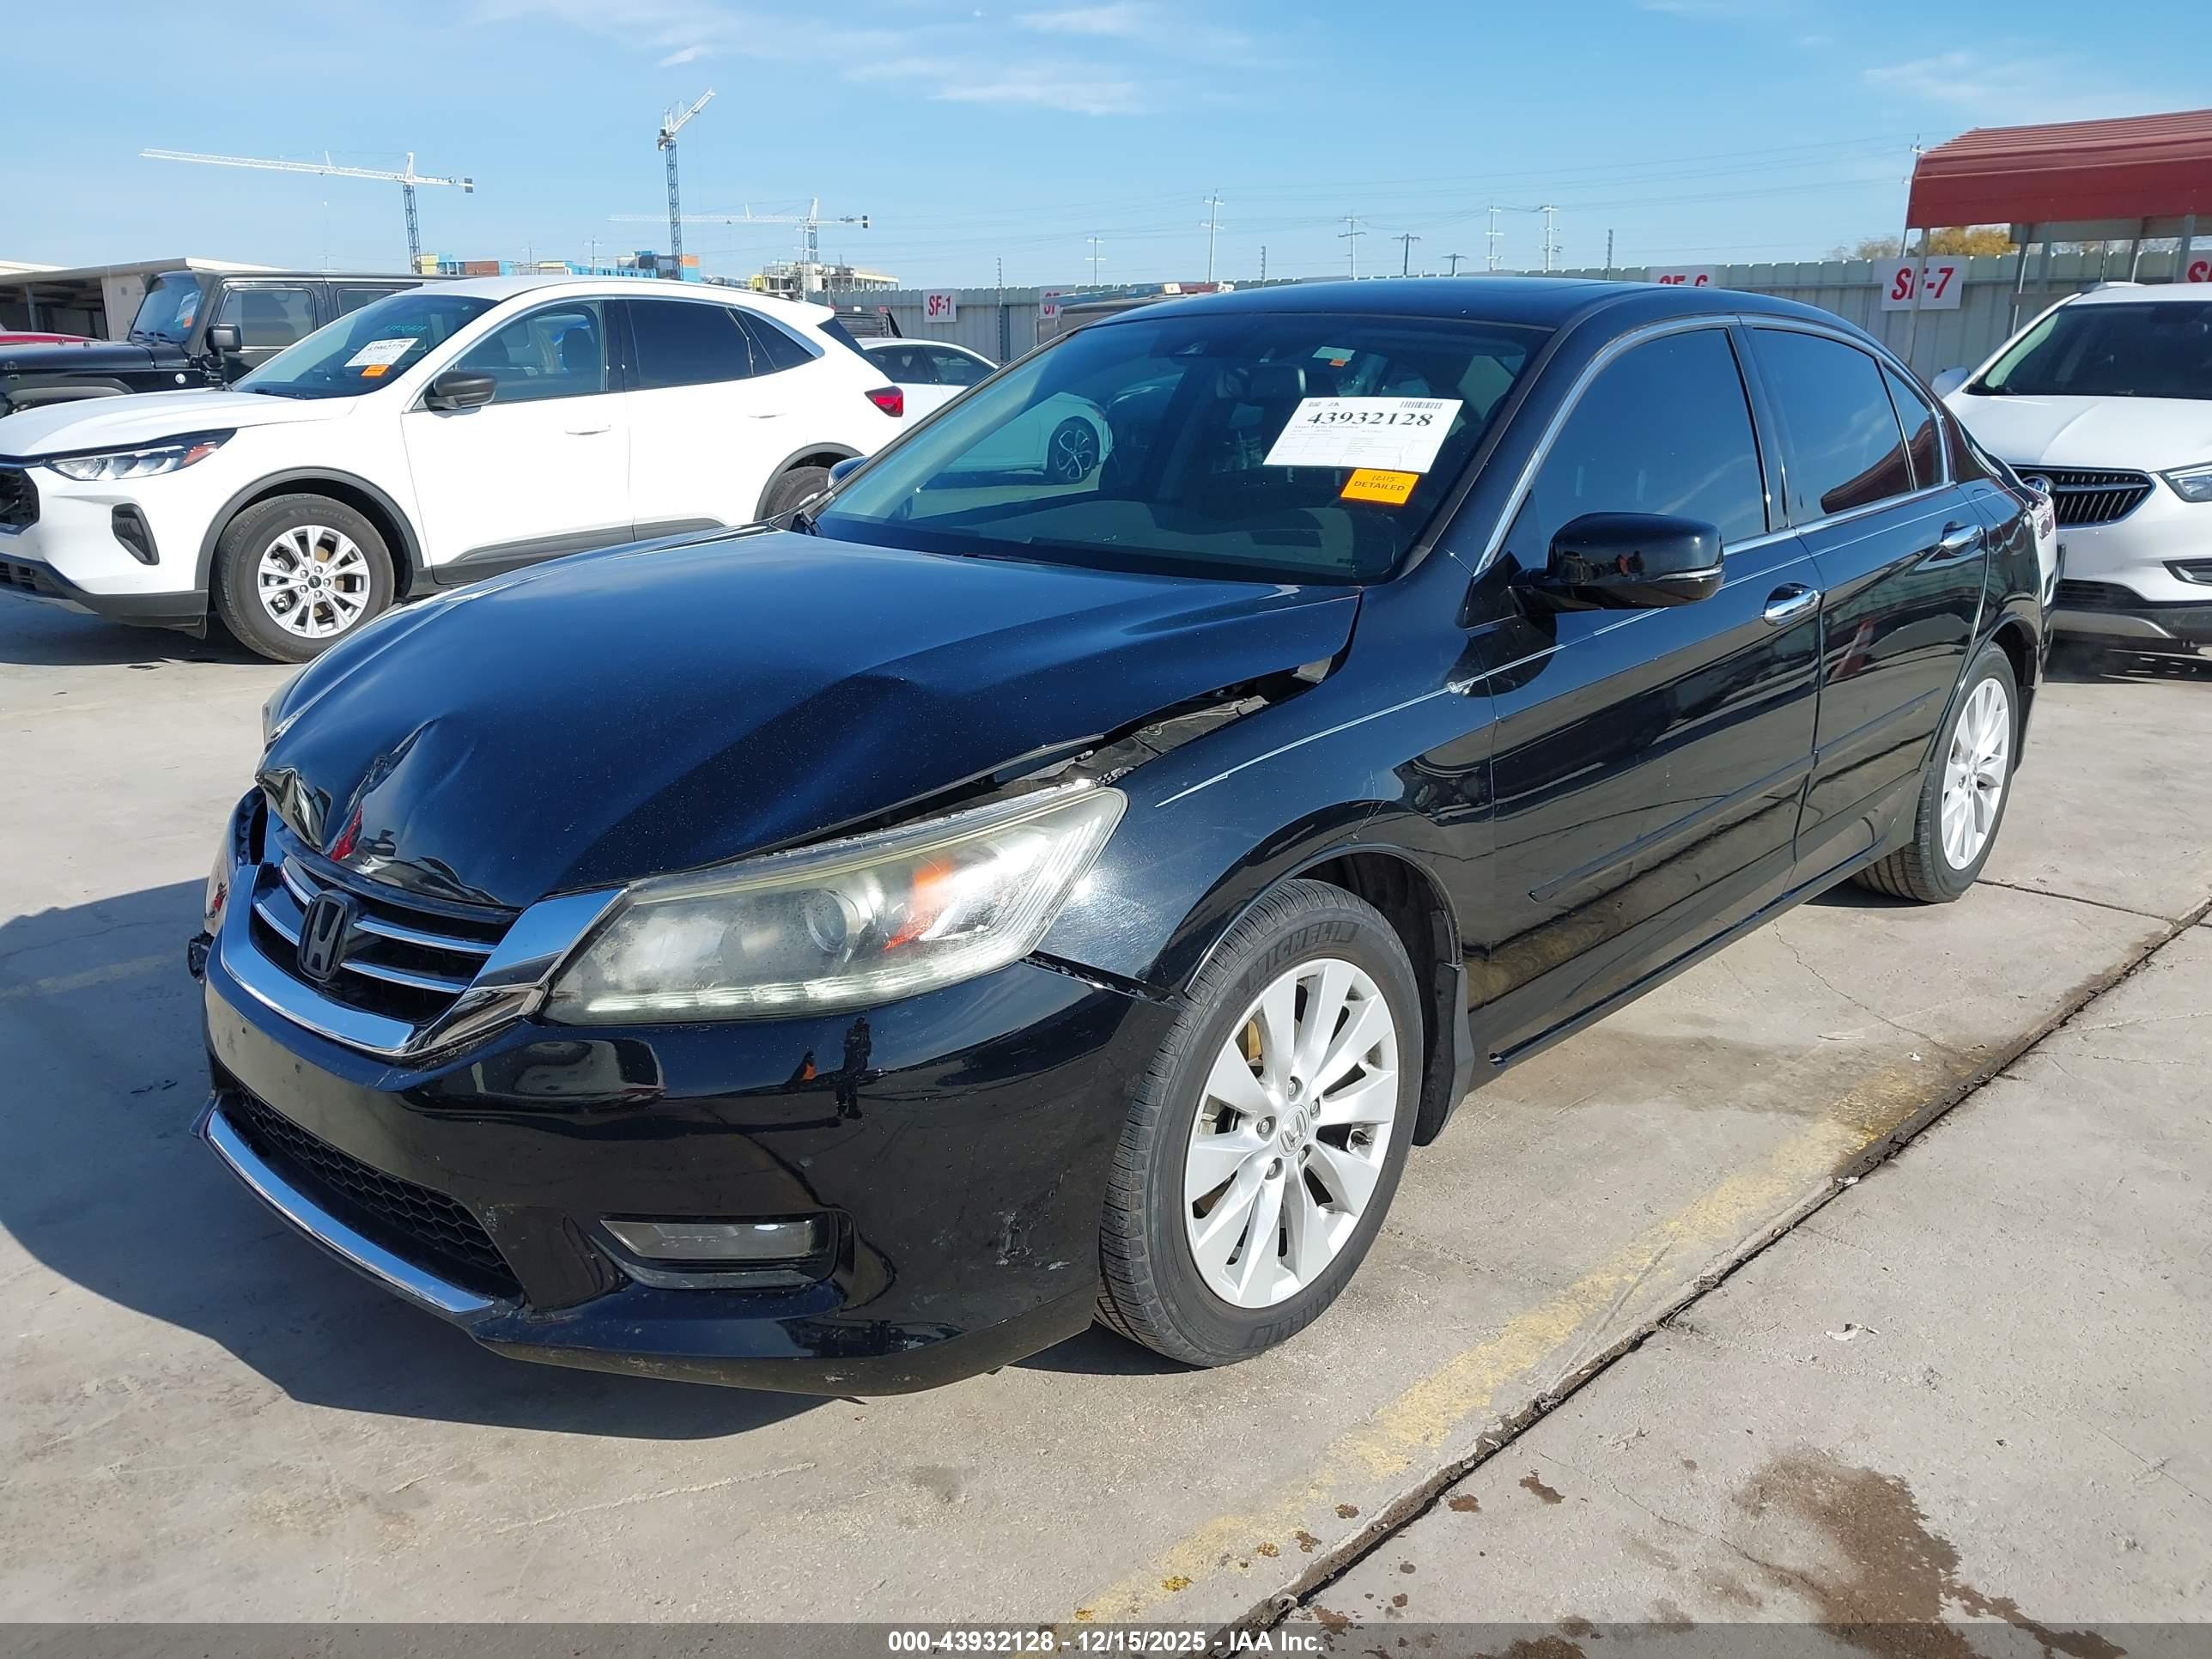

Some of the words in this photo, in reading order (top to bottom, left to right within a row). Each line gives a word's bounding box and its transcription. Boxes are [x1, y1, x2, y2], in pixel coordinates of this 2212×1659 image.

[928, 295, 951, 317] SF-1
[1307, 411, 1433, 427] 43932128
[1353, 481, 1405, 492] DETAILED
[1248, 921, 1361, 990] MICHELIN
